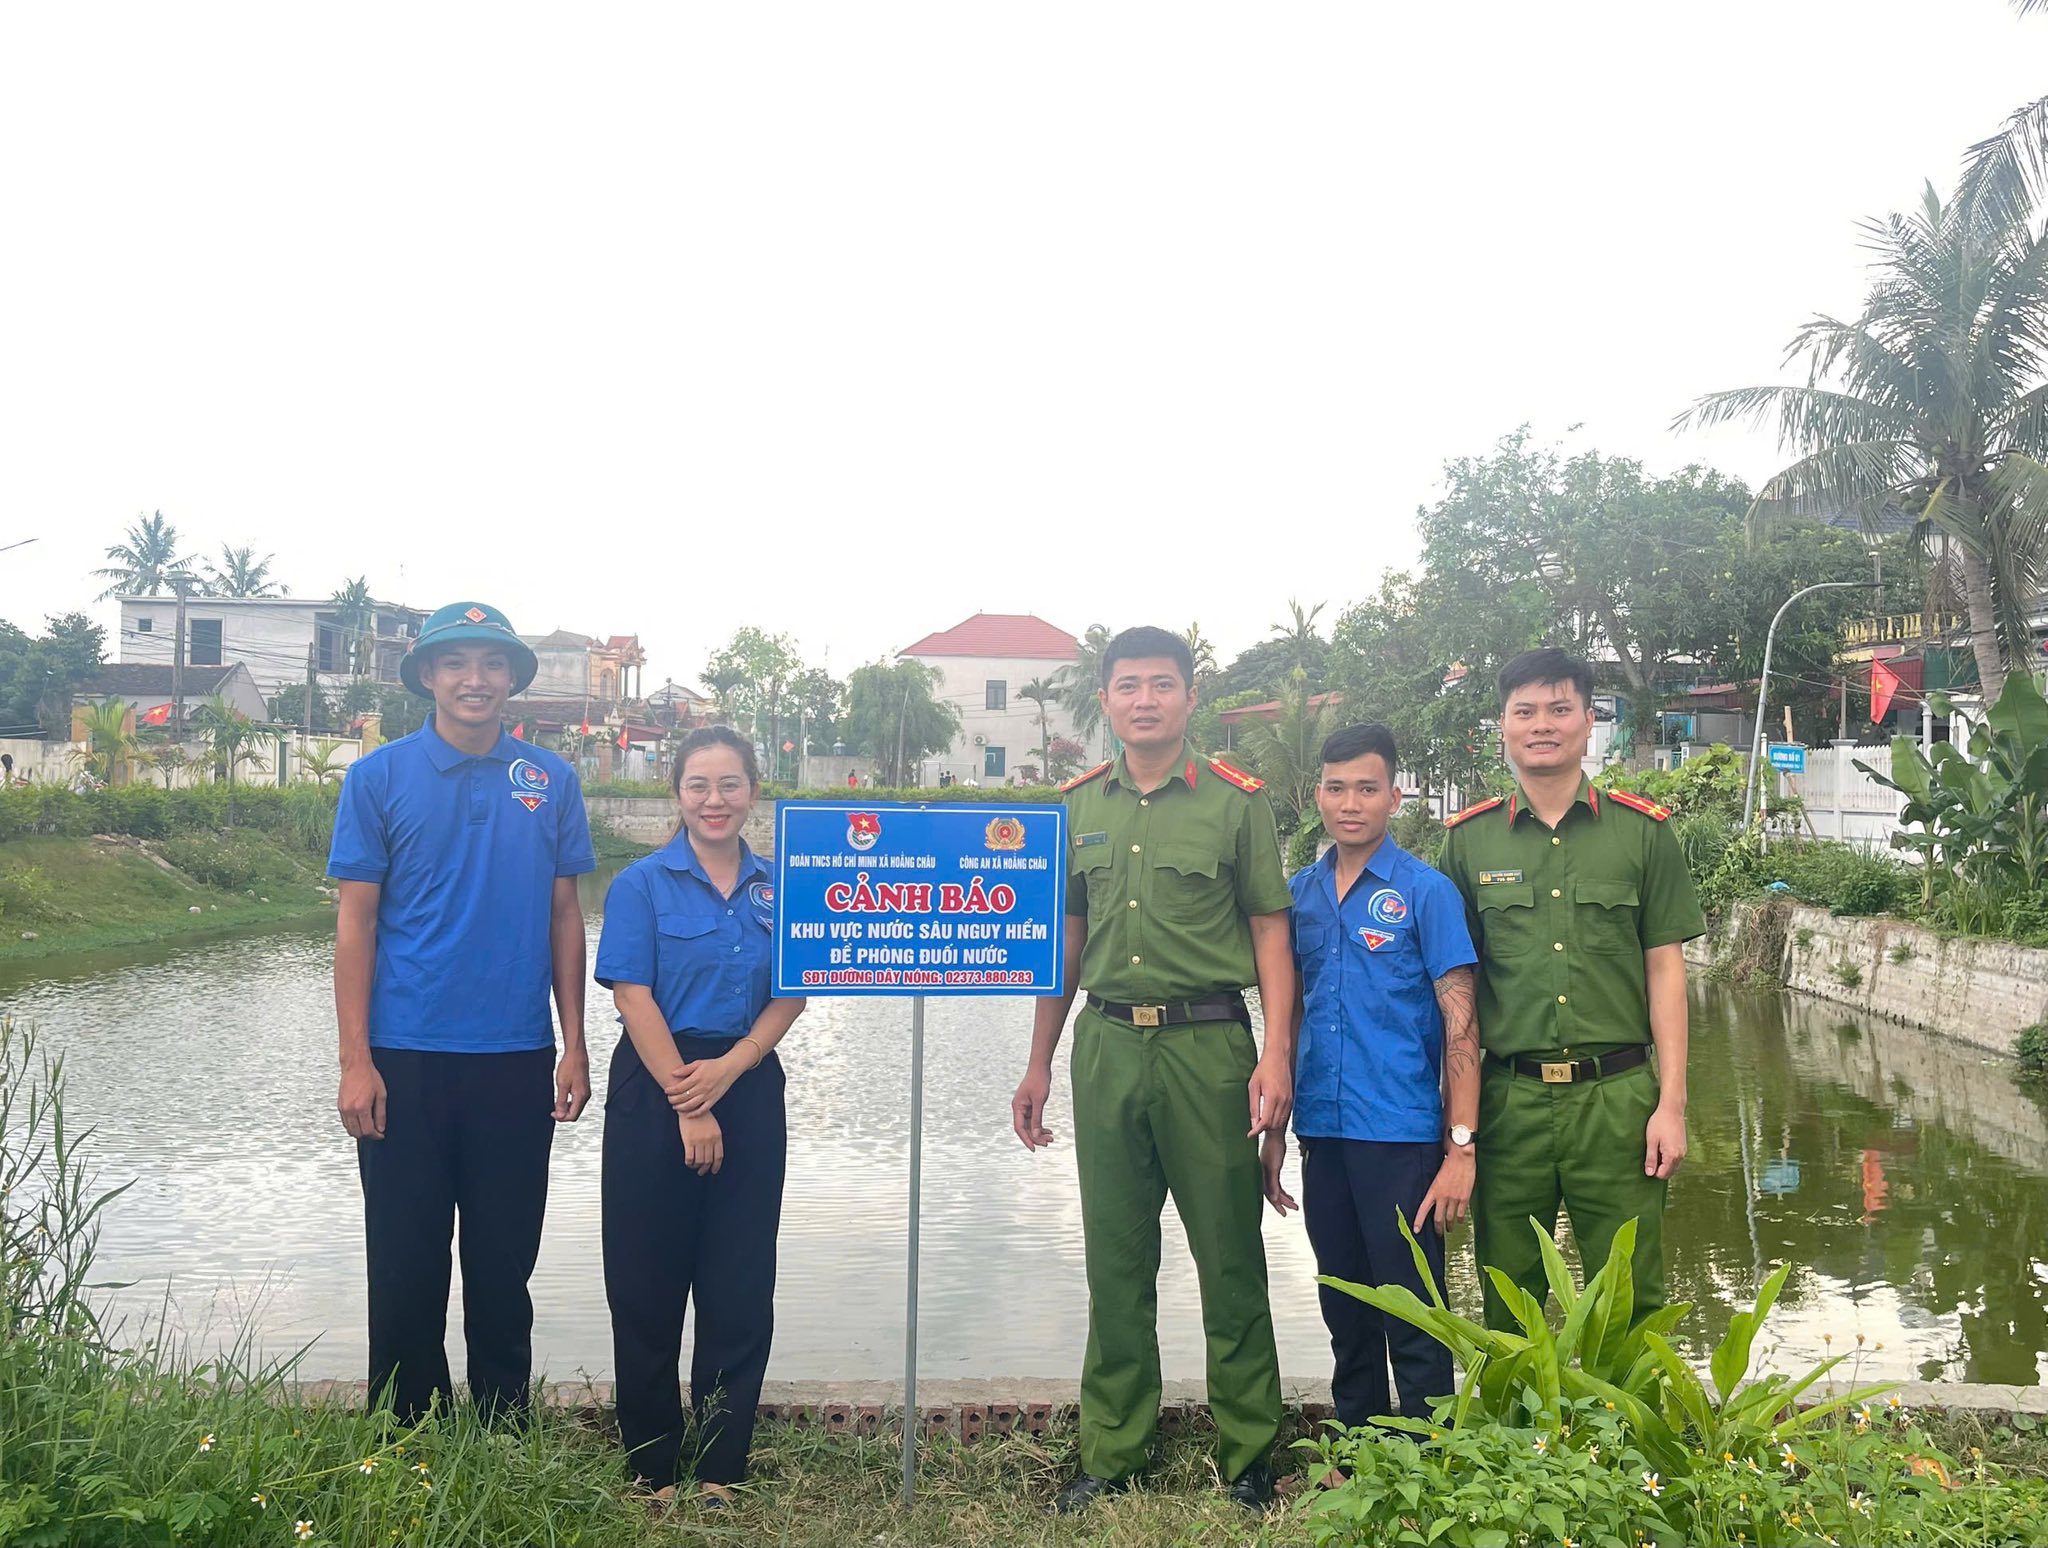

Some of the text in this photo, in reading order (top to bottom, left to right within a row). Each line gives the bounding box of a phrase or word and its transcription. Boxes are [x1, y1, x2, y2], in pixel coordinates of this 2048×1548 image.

[812, 855, 831, 868] TNCS
[858, 855, 877, 868] MINH
[959, 854, 979, 869] CÔNG
[980, 857, 991, 869] AN
[825, 872, 1016, 914] CẢNH BÁO
[791, 918, 1047, 942] KHU VỰC NƯỚC SÂU NGUY HIỂM
[830, 943, 1008, 964] ĐỀ PHÒNG ĐUỐI NƯỚC
[802, 967, 1034, 985] SĐT ĐƯỜNG DÂY NÓNG: 02373.880.283
